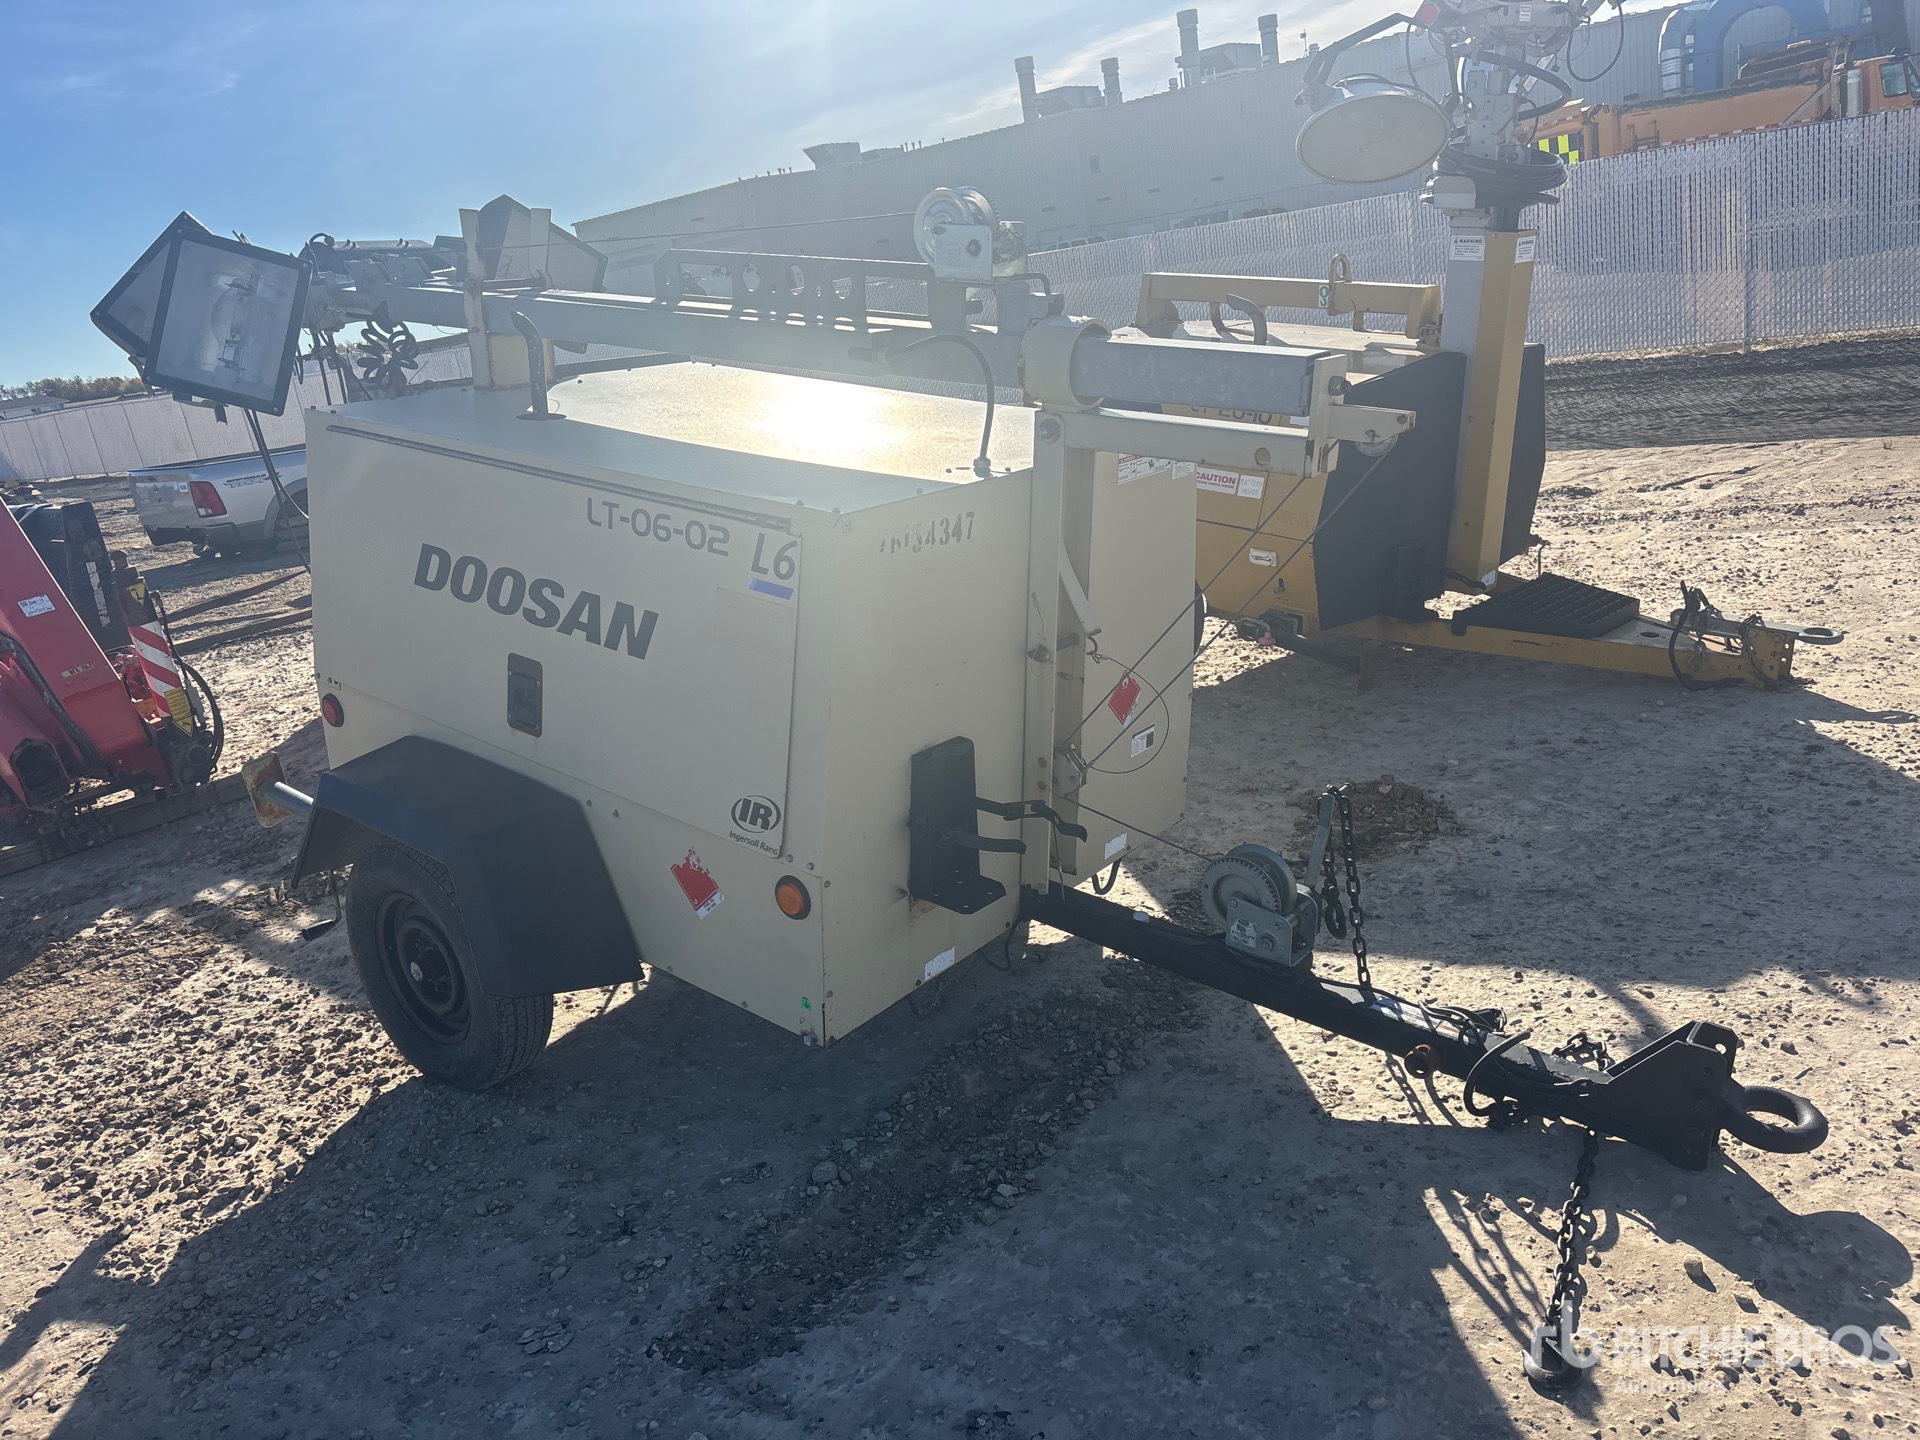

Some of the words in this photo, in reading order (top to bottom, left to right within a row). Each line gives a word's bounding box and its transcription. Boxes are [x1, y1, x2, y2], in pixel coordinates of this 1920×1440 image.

[586, 497, 731, 557] LT-06-02
[750, 532, 799, 581] L6
[413, 542, 660, 661] DOOSAN
[728, 829, 760, 848] Ingersoll
[738, 797, 773, 831] IR
